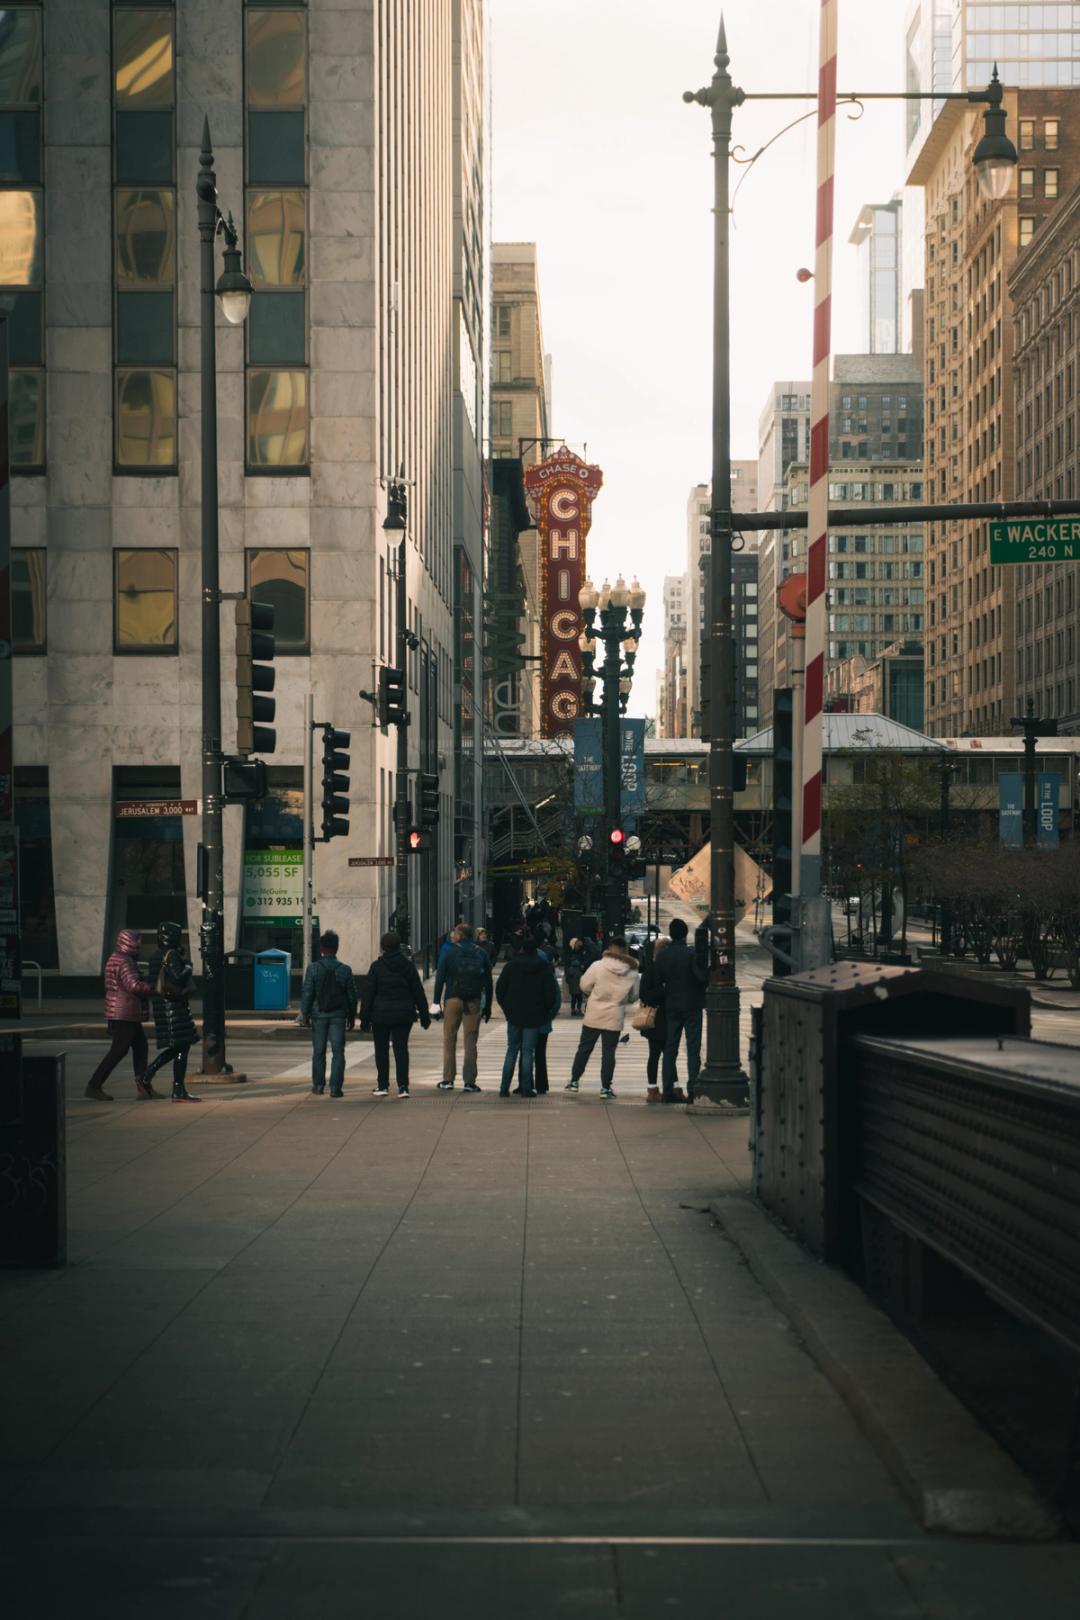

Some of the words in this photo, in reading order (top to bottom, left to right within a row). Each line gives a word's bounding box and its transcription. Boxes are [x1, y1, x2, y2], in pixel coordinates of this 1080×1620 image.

[539, 463, 577, 479] CHASE
[994, 529, 1002, 541] E
[1007, 523, 1080, 543] WACKER
[1028, 545, 1056, 558] 240
[1064, 545, 1073, 557] N
[550, 489, 578, 740] CHICAG
[622, 755, 638, 792] LOOP
[120, 807, 160, 815] JERUSALEM
[1041, 803, 1054, 831] LOOP
[246, 867, 280, 879] 5,055
[284, 867, 298, 877] SF
[257, 897, 273, 906] 312
[276, 897, 292, 906] 935
